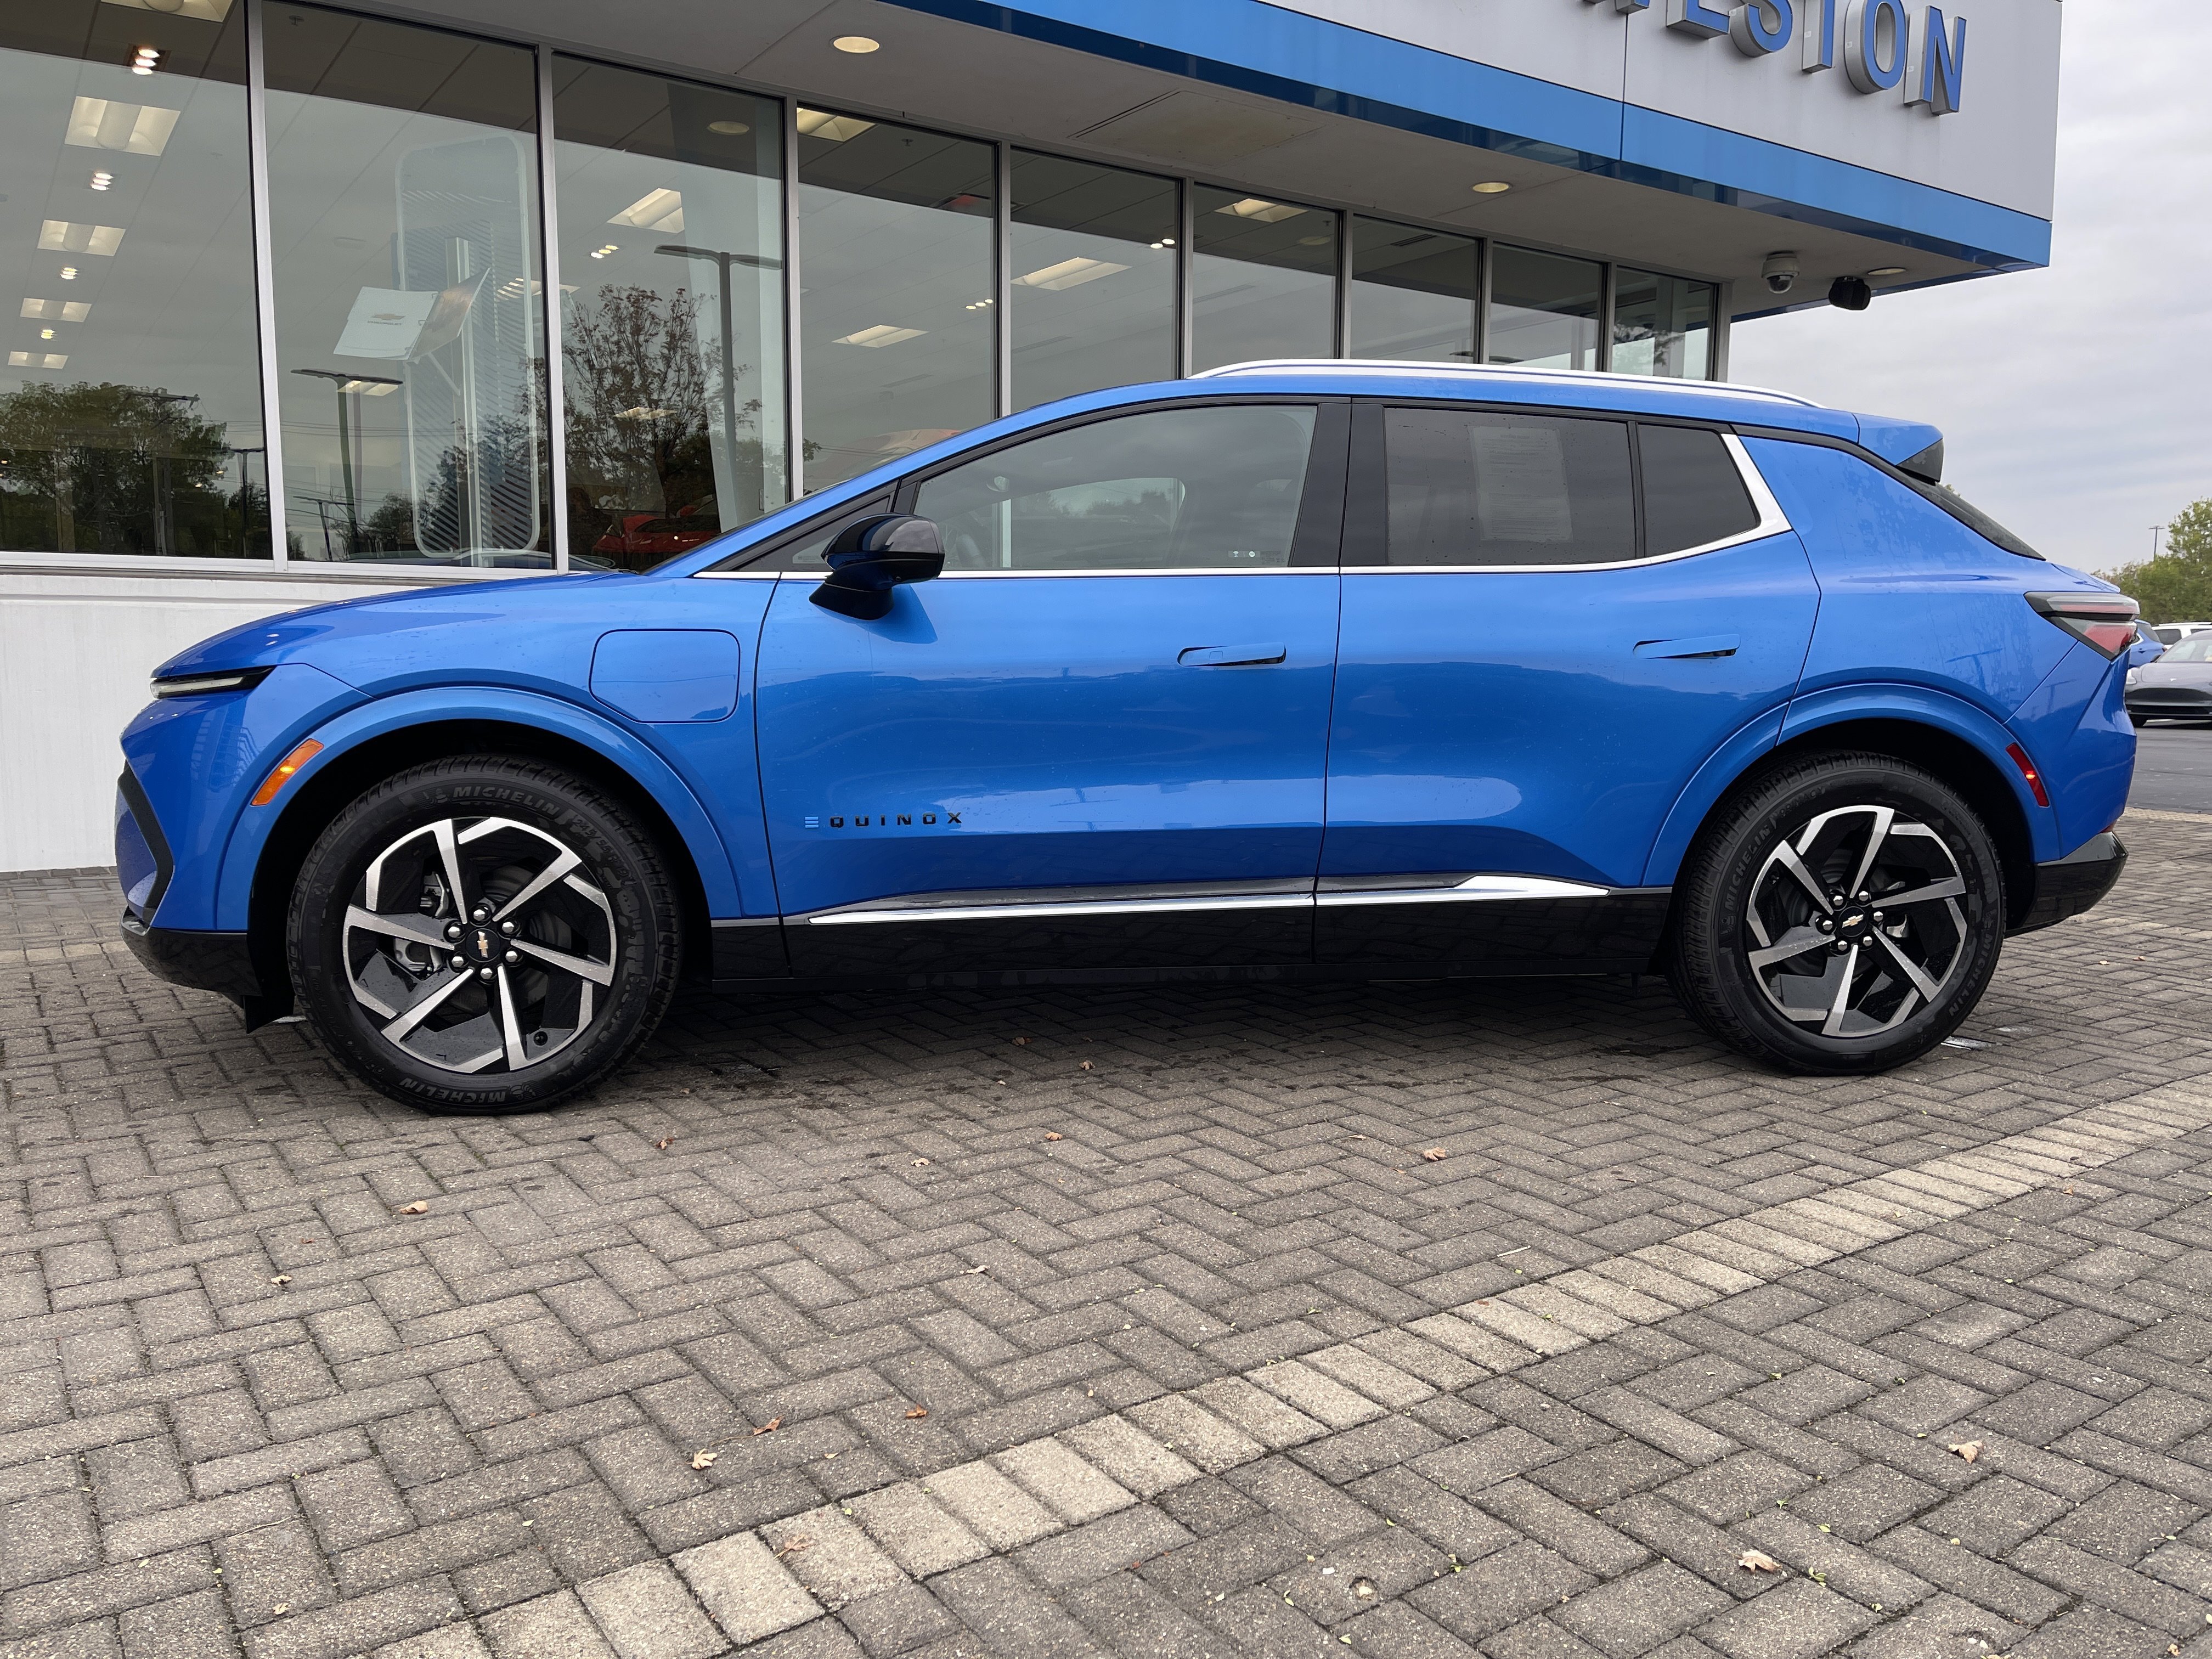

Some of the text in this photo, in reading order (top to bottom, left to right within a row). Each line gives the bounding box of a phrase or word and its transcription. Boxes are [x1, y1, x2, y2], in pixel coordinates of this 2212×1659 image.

[453, 786, 561, 816] MICHELIN
[1724, 825, 1771, 912] MICHELIN
[1948, 933, 1994, 1017] MICHELIN
[399, 1077, 506, 1103] MICHELIN
